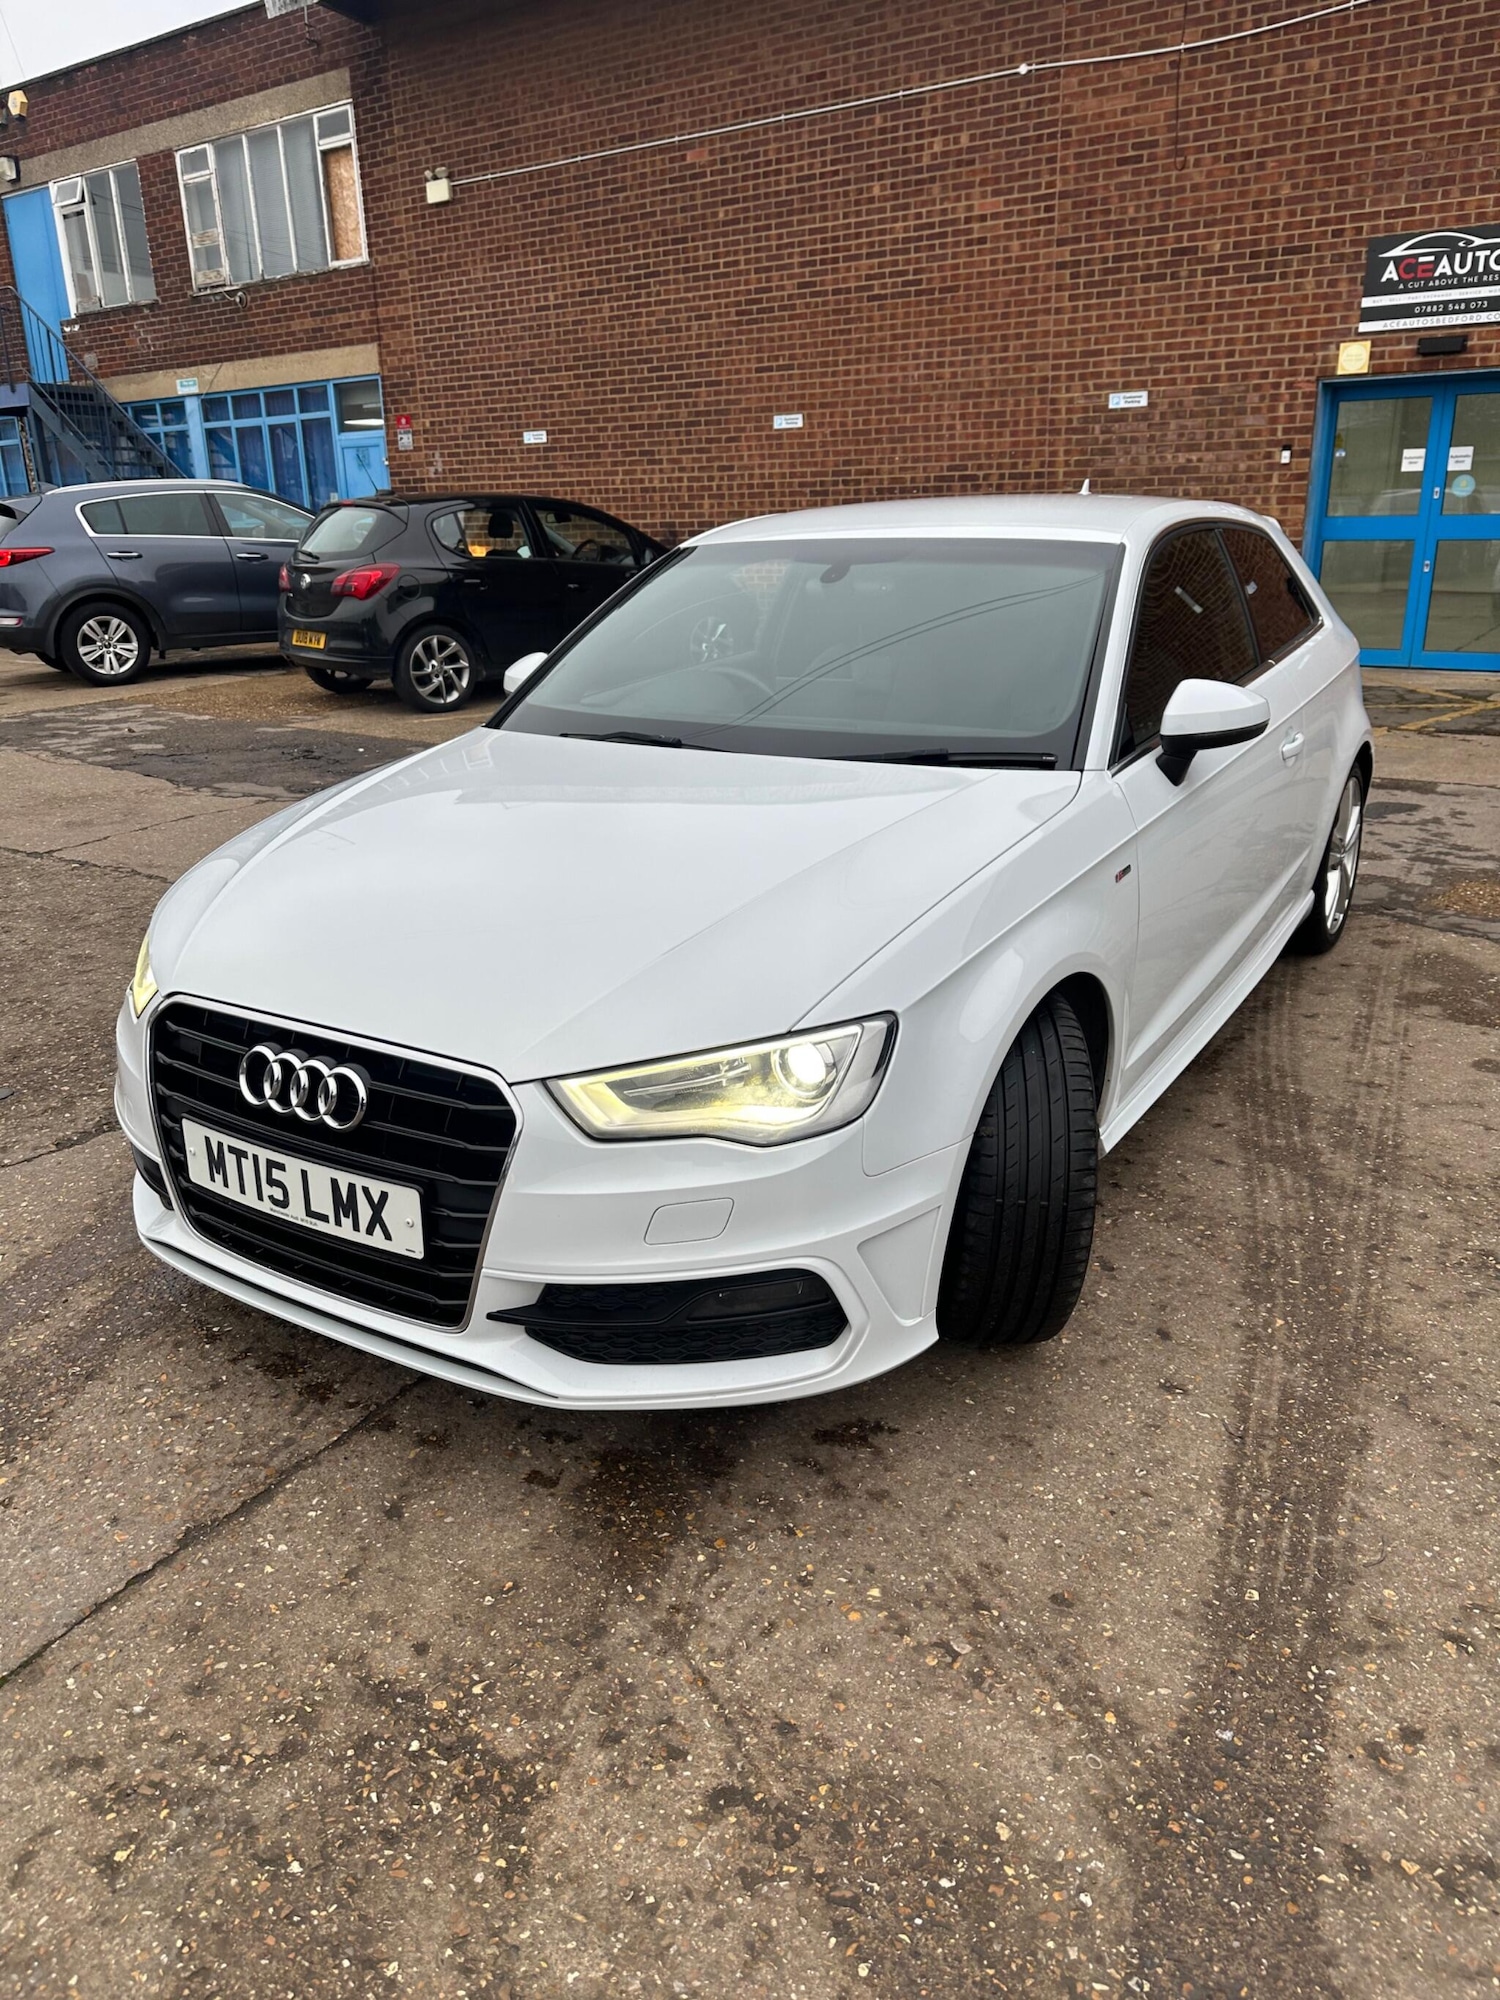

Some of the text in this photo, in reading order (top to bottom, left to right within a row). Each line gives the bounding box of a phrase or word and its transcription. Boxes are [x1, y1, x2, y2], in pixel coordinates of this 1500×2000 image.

[1408, 280, 1425, 288] CUT
[1428, 278, 1458, 287] ABOVE
[1462, 275, 1478, 283] THE
[1414, 300, 1488, 313] 07882 548 073
[204, 1135, 393, 1242] MT15 LMX
